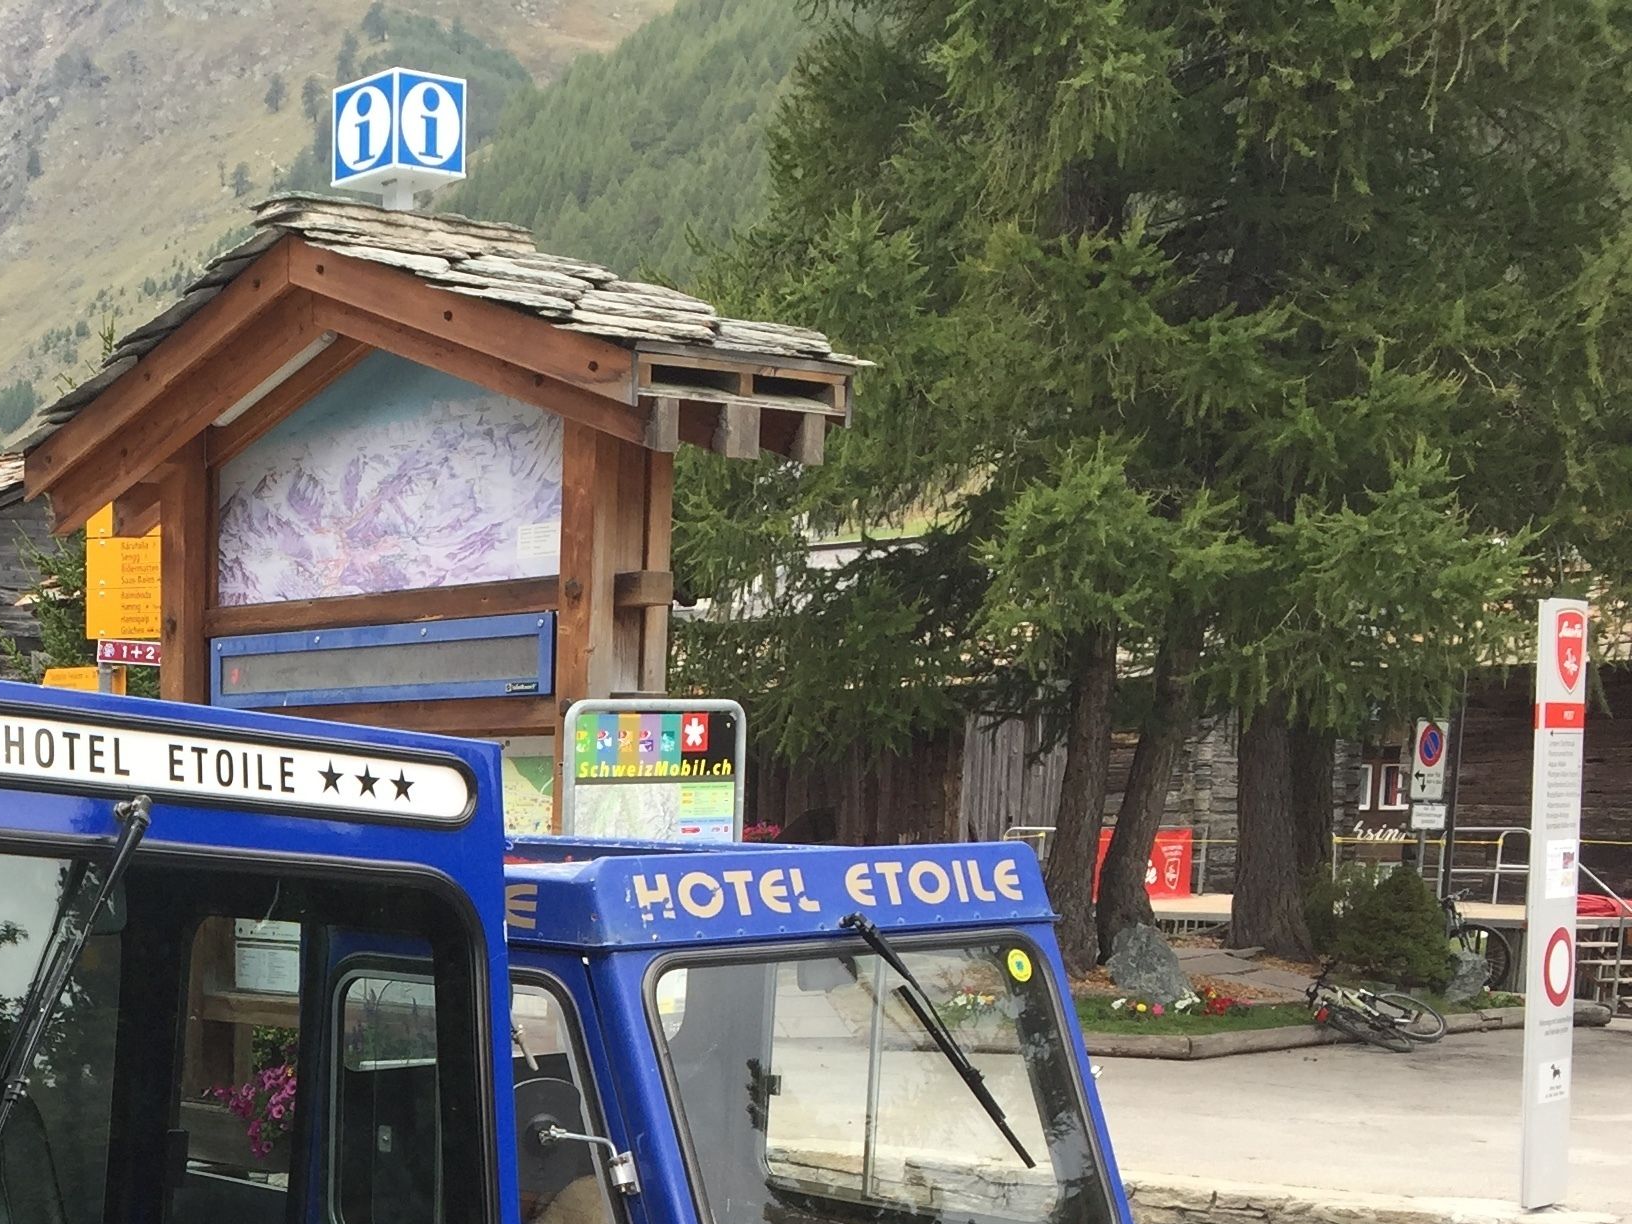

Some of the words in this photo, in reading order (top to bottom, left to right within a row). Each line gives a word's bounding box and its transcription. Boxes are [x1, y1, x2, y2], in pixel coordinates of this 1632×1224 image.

[168, 743, 296, 794] ETOILE
[578, 758, 732, 779] SchweizMobil.ch
[632, 867, 821, 922] HOTEL
[844, 858, 1024, 907] ETOILE
